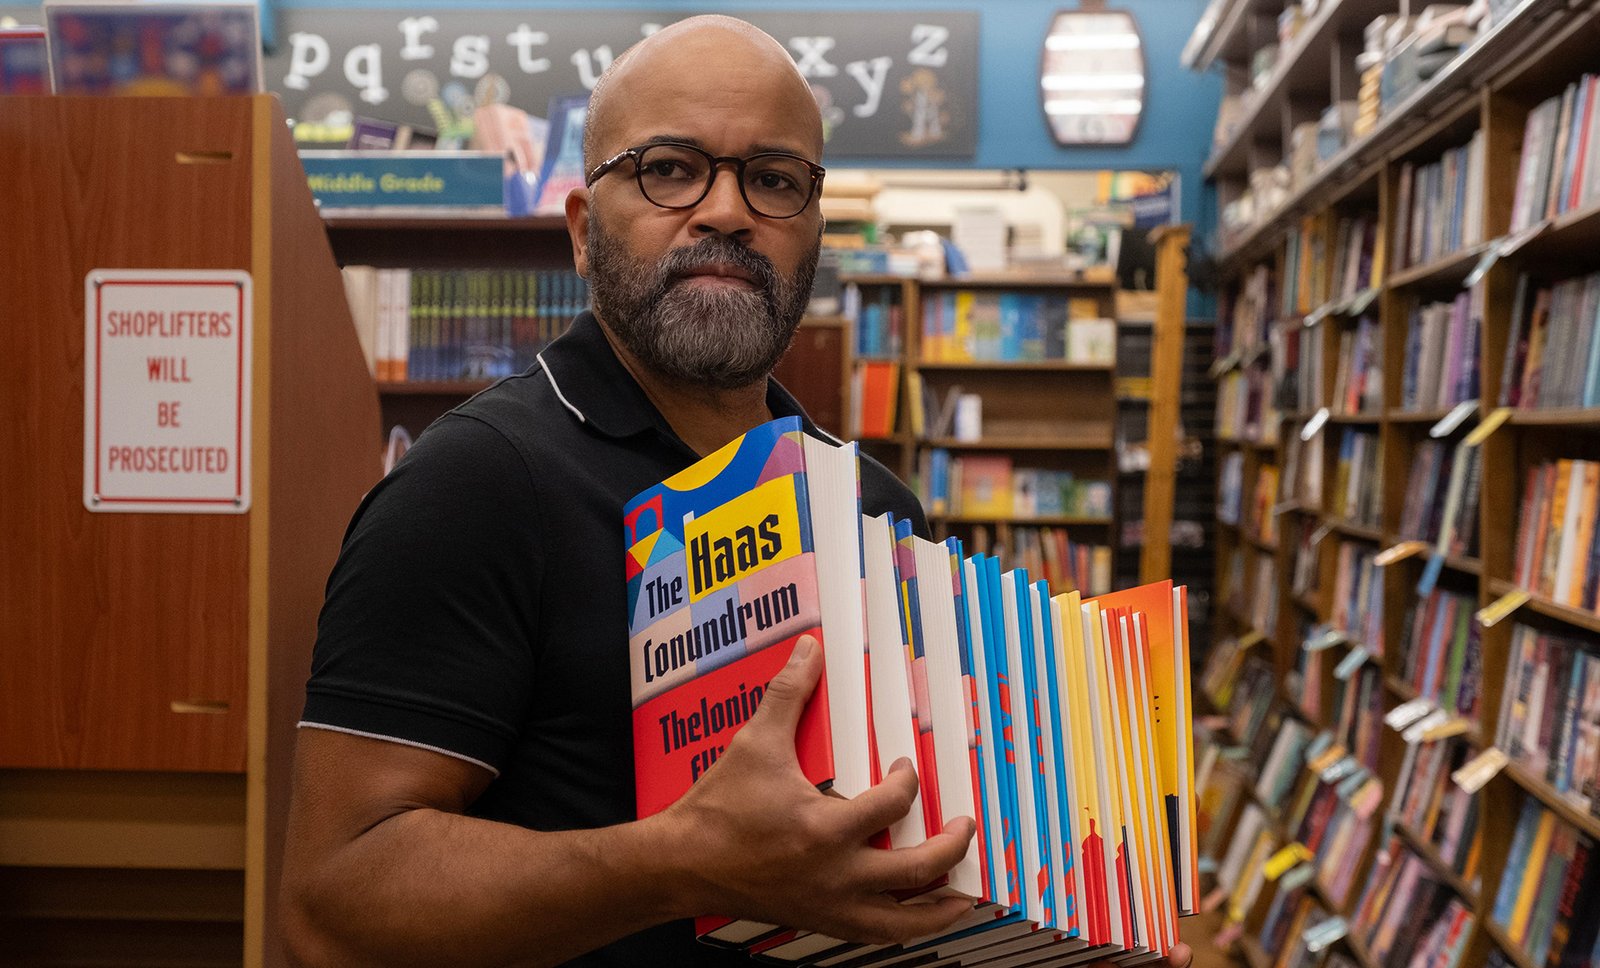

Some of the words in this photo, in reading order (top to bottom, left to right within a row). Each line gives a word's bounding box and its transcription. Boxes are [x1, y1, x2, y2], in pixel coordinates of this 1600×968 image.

[379, 172, 445, 193] Grade
[107, 311, 232, 338] SHOPLIFTERS
[147, 356, 191, 383] WILL
[157, 401, 180, 428] BE
[108, 445, 228, 474] PROSECUTED
[645, 575, 683, 619] The
[690, 513, 783, 596] Haas
[643, 582, 800, 684] Conundrum
[659, 681, 770, 755] Thelonio
